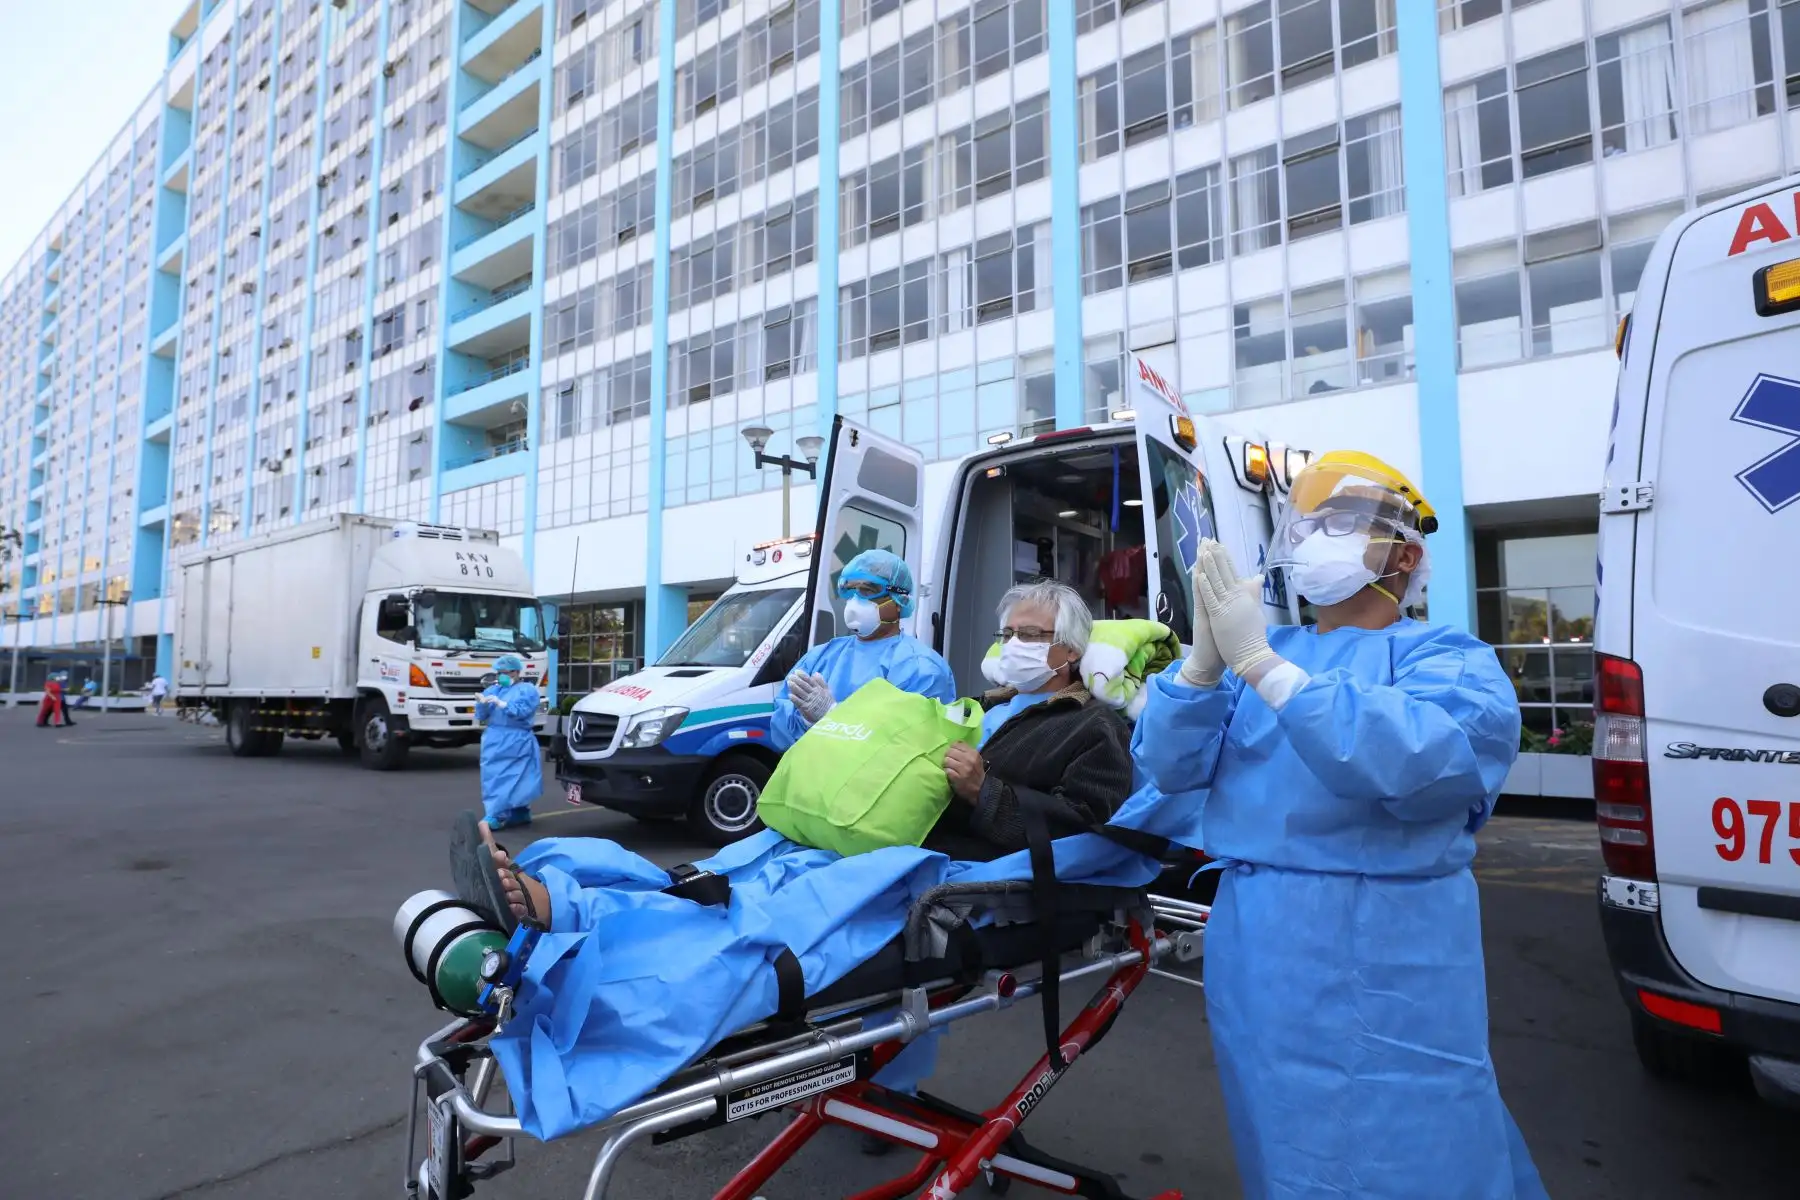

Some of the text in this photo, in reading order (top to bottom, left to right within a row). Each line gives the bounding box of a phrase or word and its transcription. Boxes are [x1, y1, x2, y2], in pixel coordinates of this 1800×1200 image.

[1728, 191, 1800, 257] A
[456, 551, 489, 563] AKV
[461, 563, 494, 578] 810
[731, 1069, 852, 1114] COT IS FOR PROFESSIONAL USE ONLY
[751, 1063, 841, 1095] DO NOT REMOVE THIS HAND GUARD
